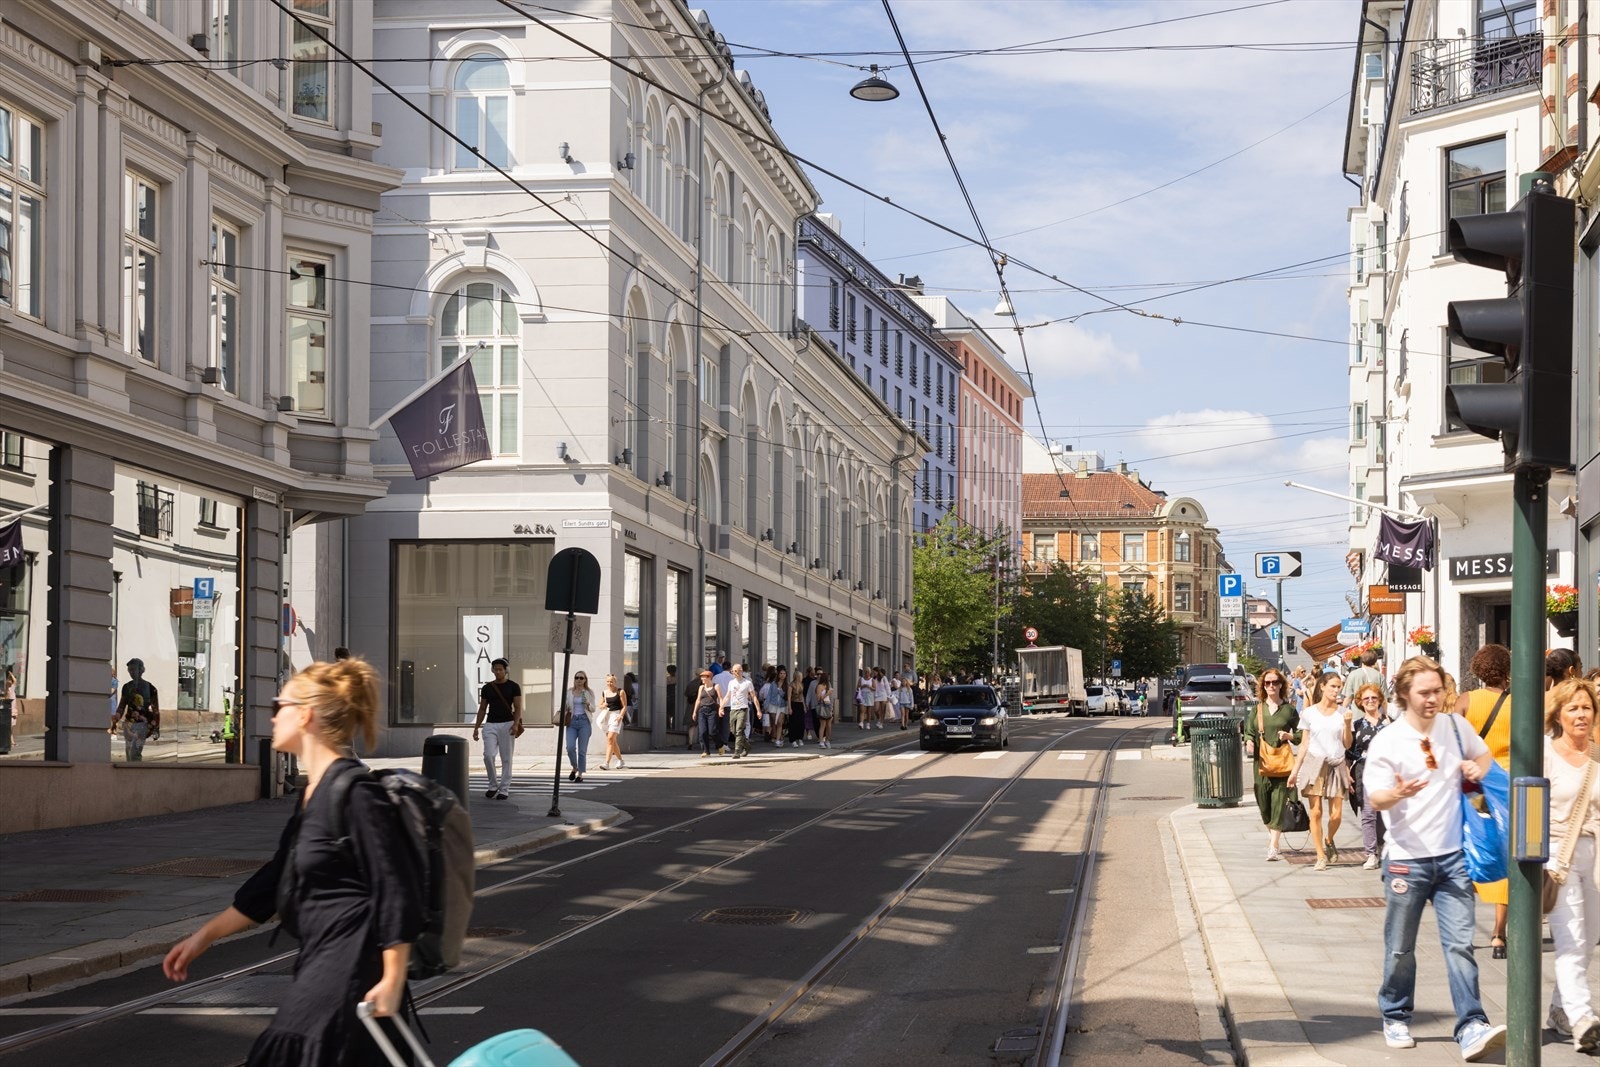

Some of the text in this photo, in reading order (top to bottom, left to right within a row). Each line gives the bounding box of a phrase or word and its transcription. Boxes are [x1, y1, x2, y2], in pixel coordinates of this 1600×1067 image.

[513, 523, 557, 535] ZARA
[1380, 541, 1427, 562] MESS
[1267, 562, 1276, 573] P
[1225, 577, 1236, 595] P
